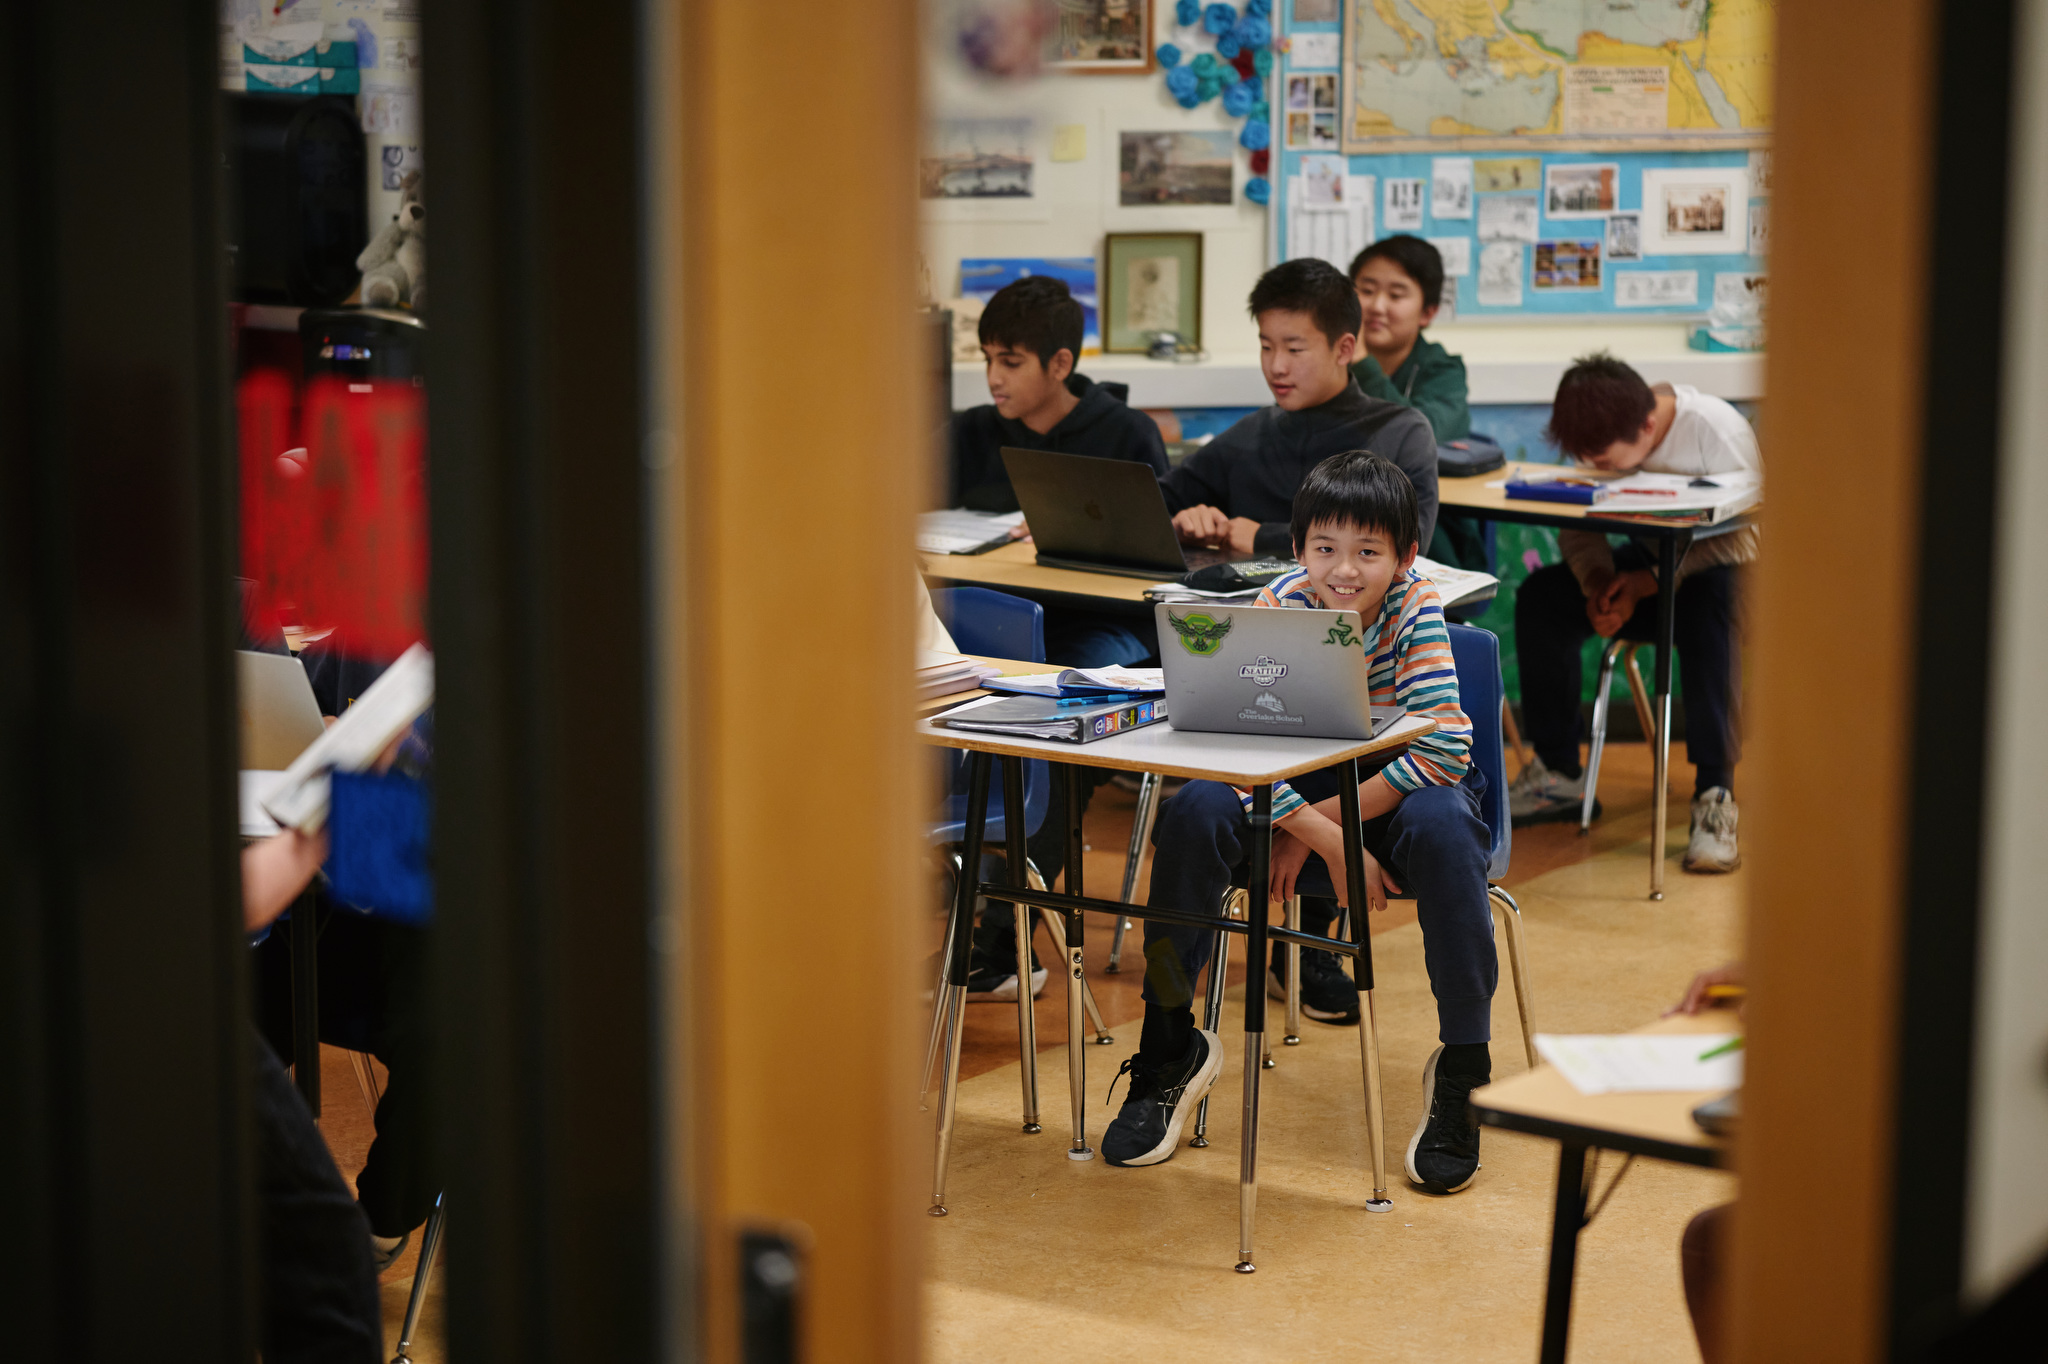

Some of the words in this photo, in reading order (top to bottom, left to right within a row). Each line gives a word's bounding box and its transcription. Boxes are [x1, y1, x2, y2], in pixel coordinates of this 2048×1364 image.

[1245, 667, 1280, 675] SEATTLE
[1238, 712, 1275, 721] Overlake
[1275, 714, 1303, 723] School
